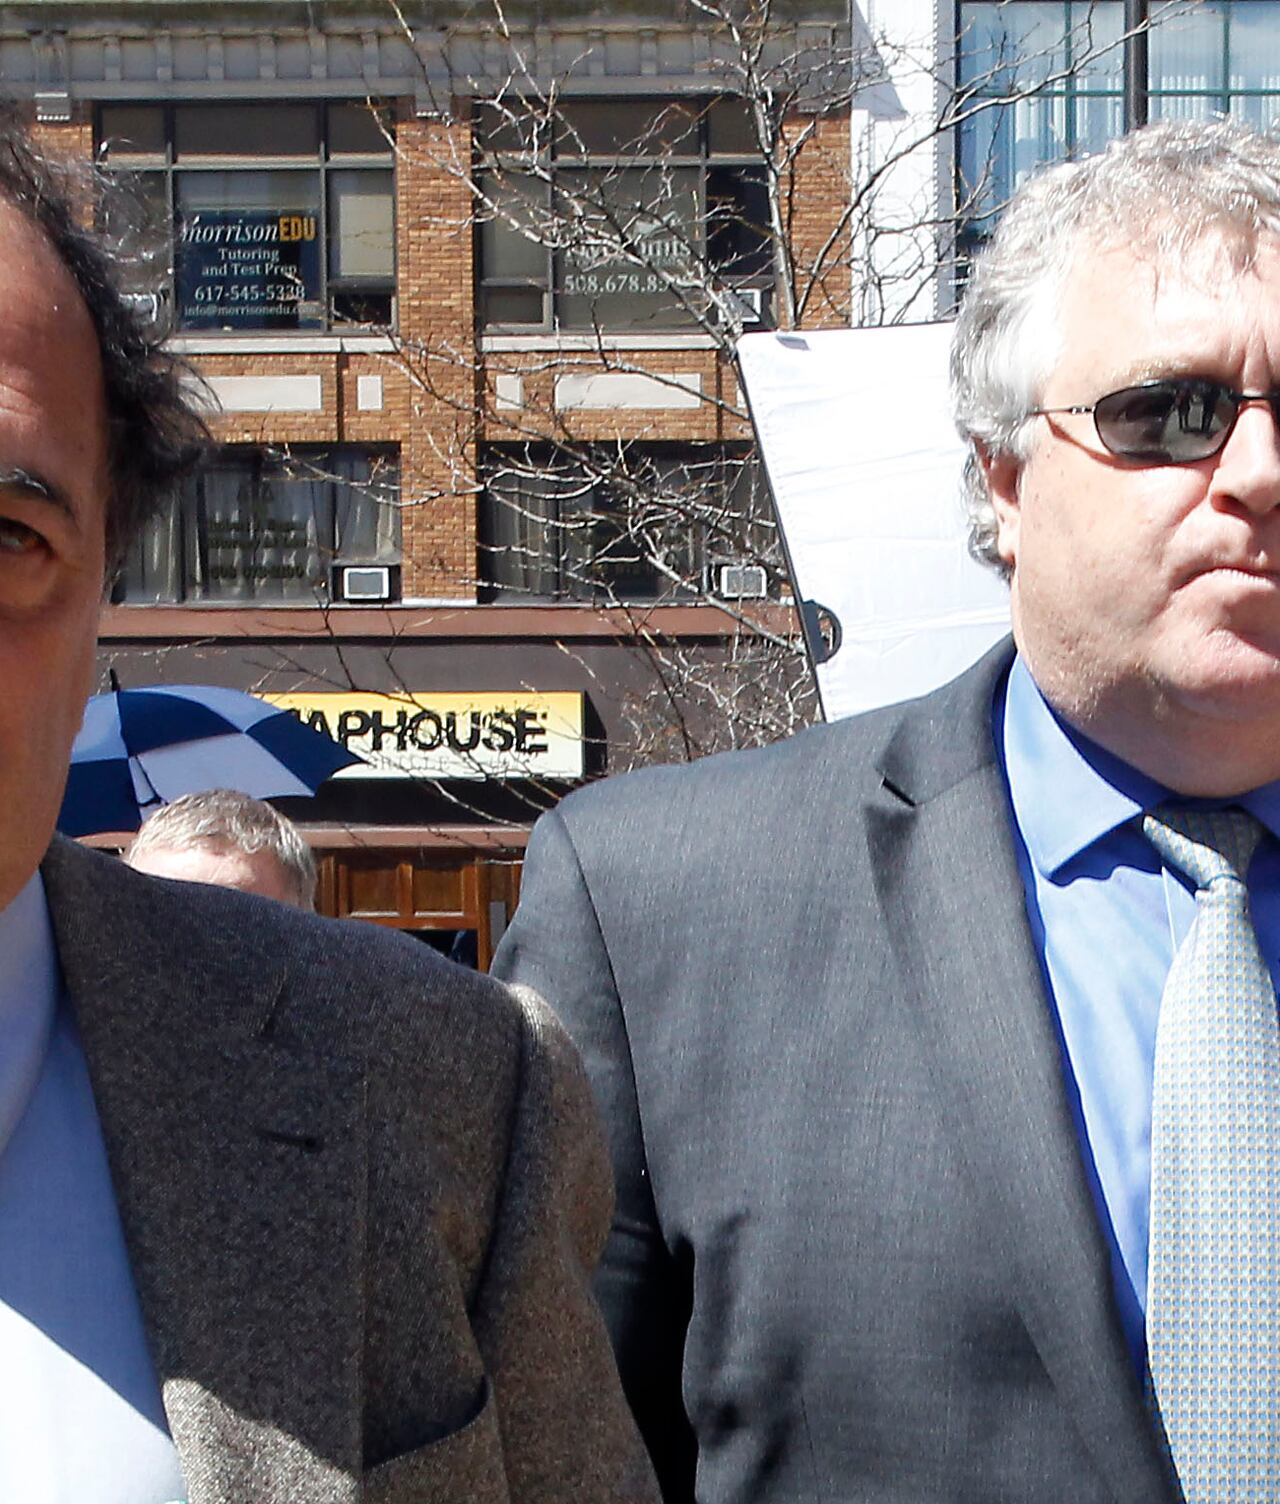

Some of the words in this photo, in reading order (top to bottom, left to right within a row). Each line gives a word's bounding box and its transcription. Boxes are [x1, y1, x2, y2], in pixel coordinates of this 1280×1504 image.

[218, 247, 280, 263] Tutoring
[201, 264, 227, 276] and
[230, 263, 261, 276] Test
[264, 263, 297, 279] Prep
[286, 708, 548, 753] APHOUSE
